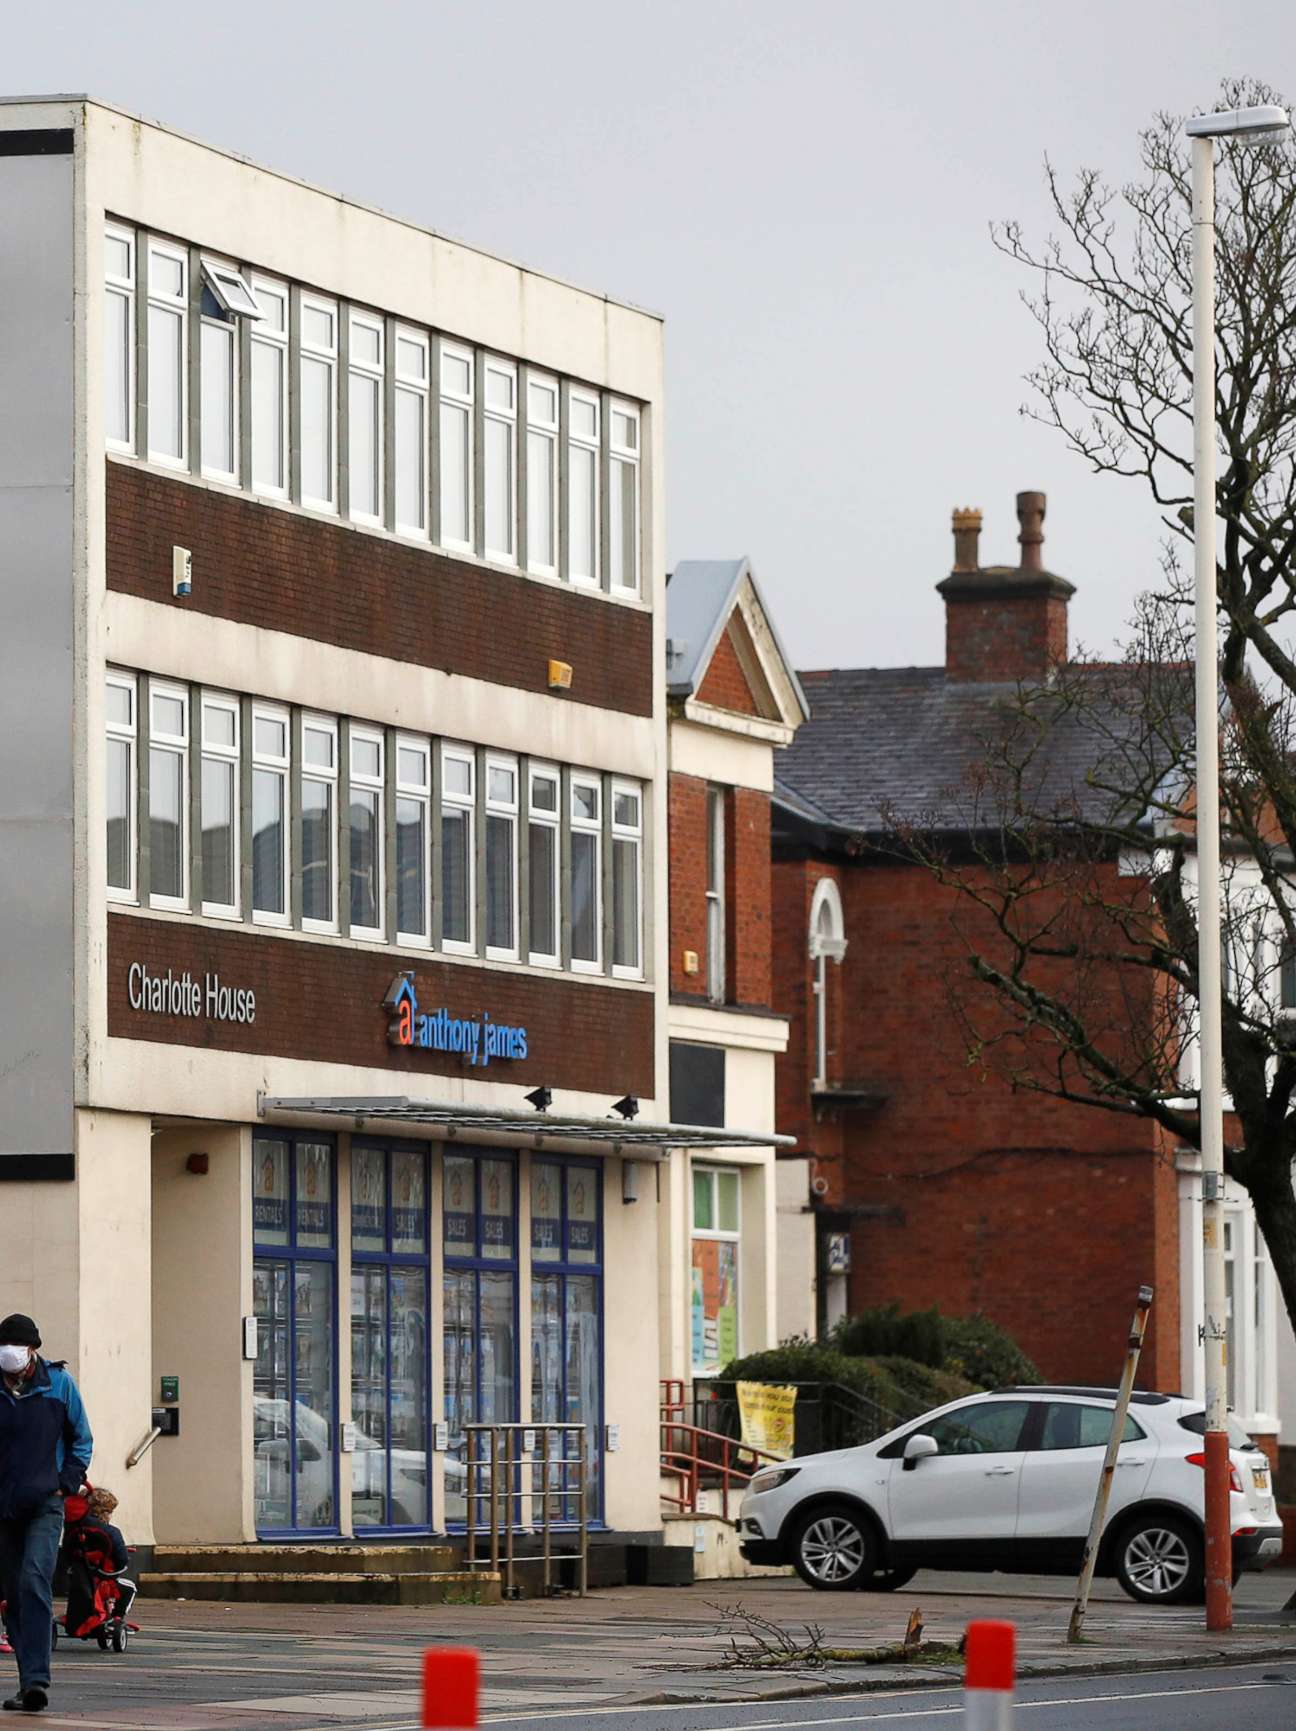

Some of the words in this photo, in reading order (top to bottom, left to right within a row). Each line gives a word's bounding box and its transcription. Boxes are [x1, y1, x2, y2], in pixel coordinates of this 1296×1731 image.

[129, 962, 201, 1017] Charlotte
[206, 972, 256, 1024] House
[420, 1007, 480, 1065] anthony
[481, 1011, 528, 1067] james
